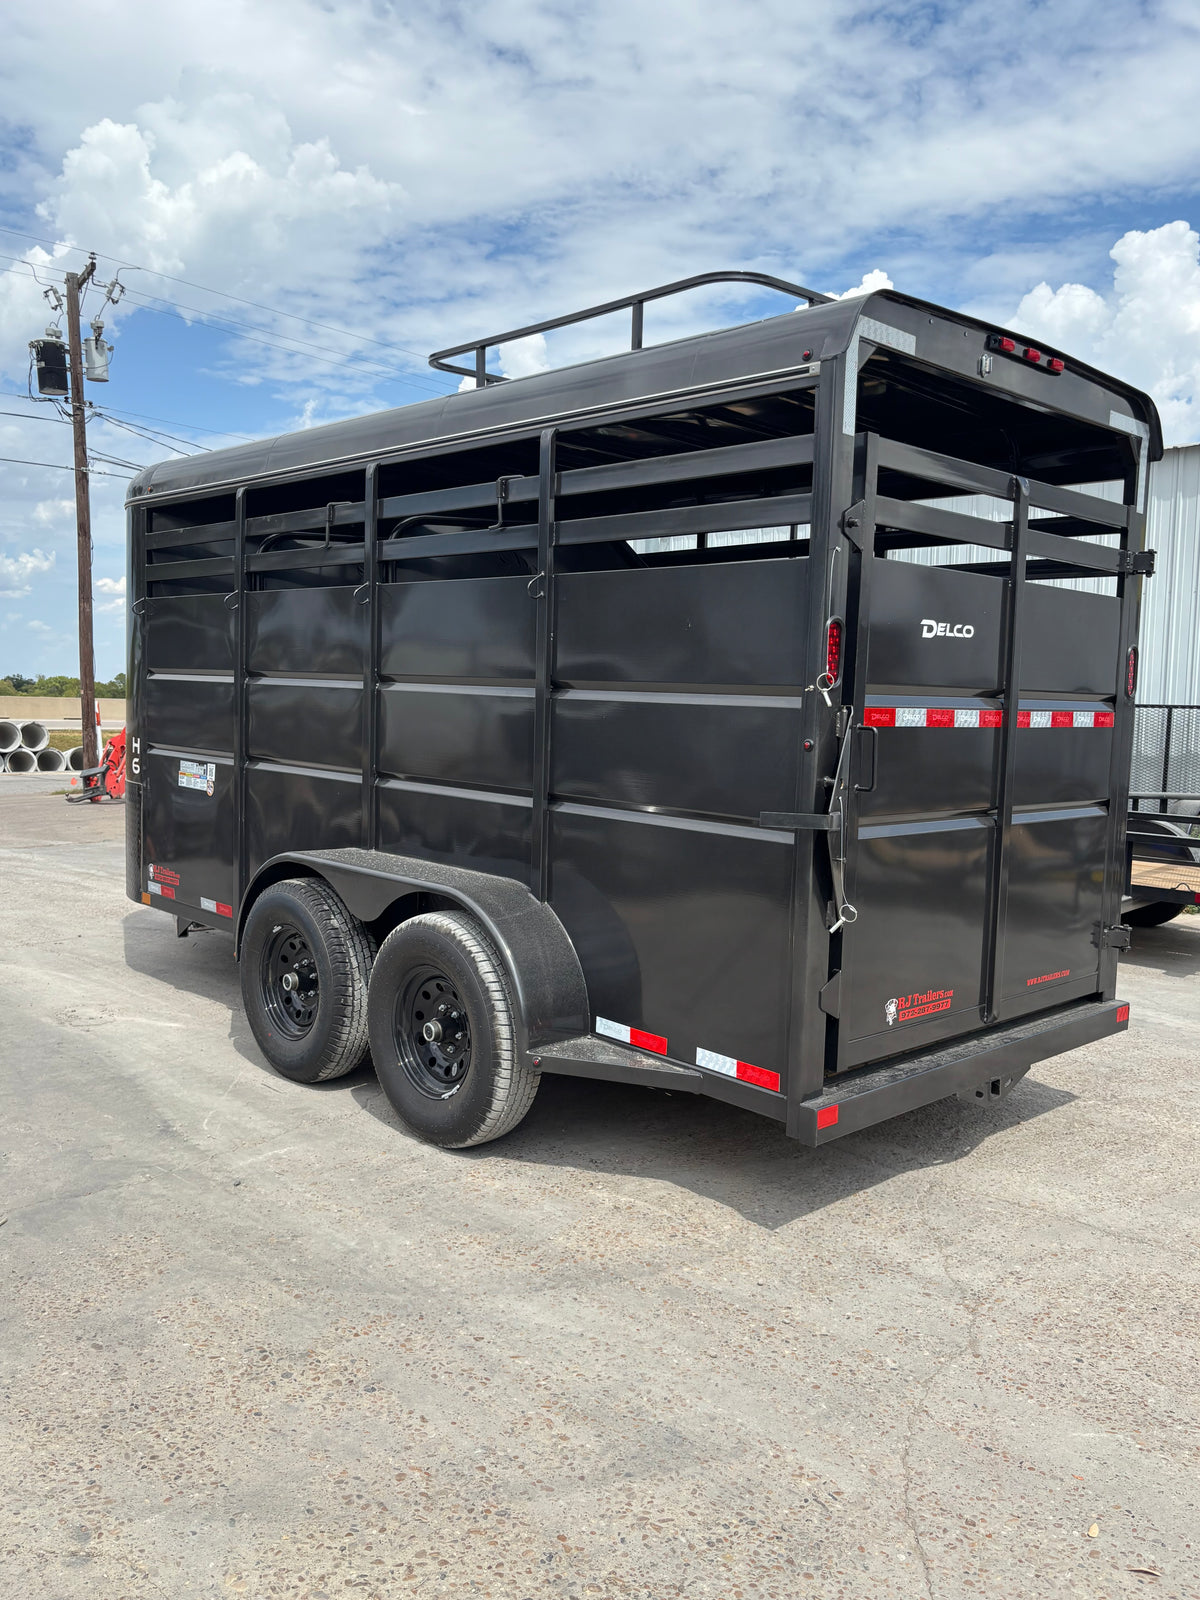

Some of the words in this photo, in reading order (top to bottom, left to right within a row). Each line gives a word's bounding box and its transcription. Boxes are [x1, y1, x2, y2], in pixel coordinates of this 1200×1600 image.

[920, 619, 975, 639] DELCO
[897, 995, 912, 1010] RJ
[901, 1000, 949, 1018] 972-287-9977
